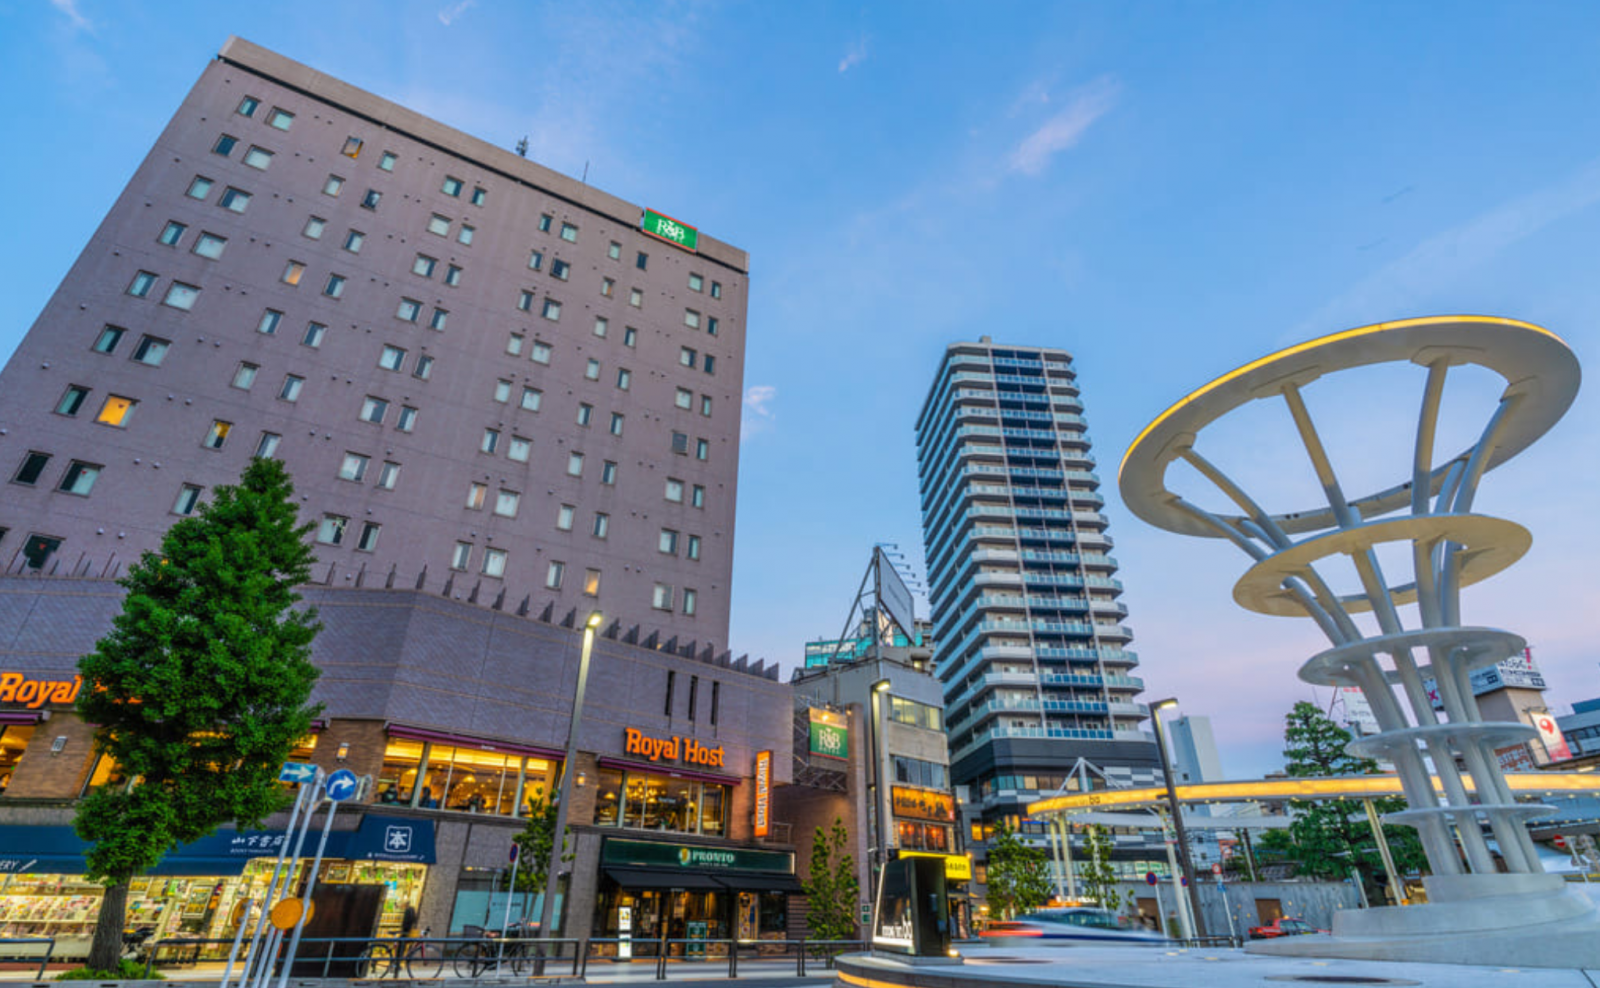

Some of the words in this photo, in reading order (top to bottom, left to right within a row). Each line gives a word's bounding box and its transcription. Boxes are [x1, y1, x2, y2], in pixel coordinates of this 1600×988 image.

[656, 218, 685, 244] R&B
[0, 671, 83, 709] Royal
[625, 726, 680, 761] Royal
[683, 737, 725, 767] Host
[818, 727, 841, 752] R&B
[389, 830, 408, 850] 本
[692, 850, 735, 864] PRONTO
